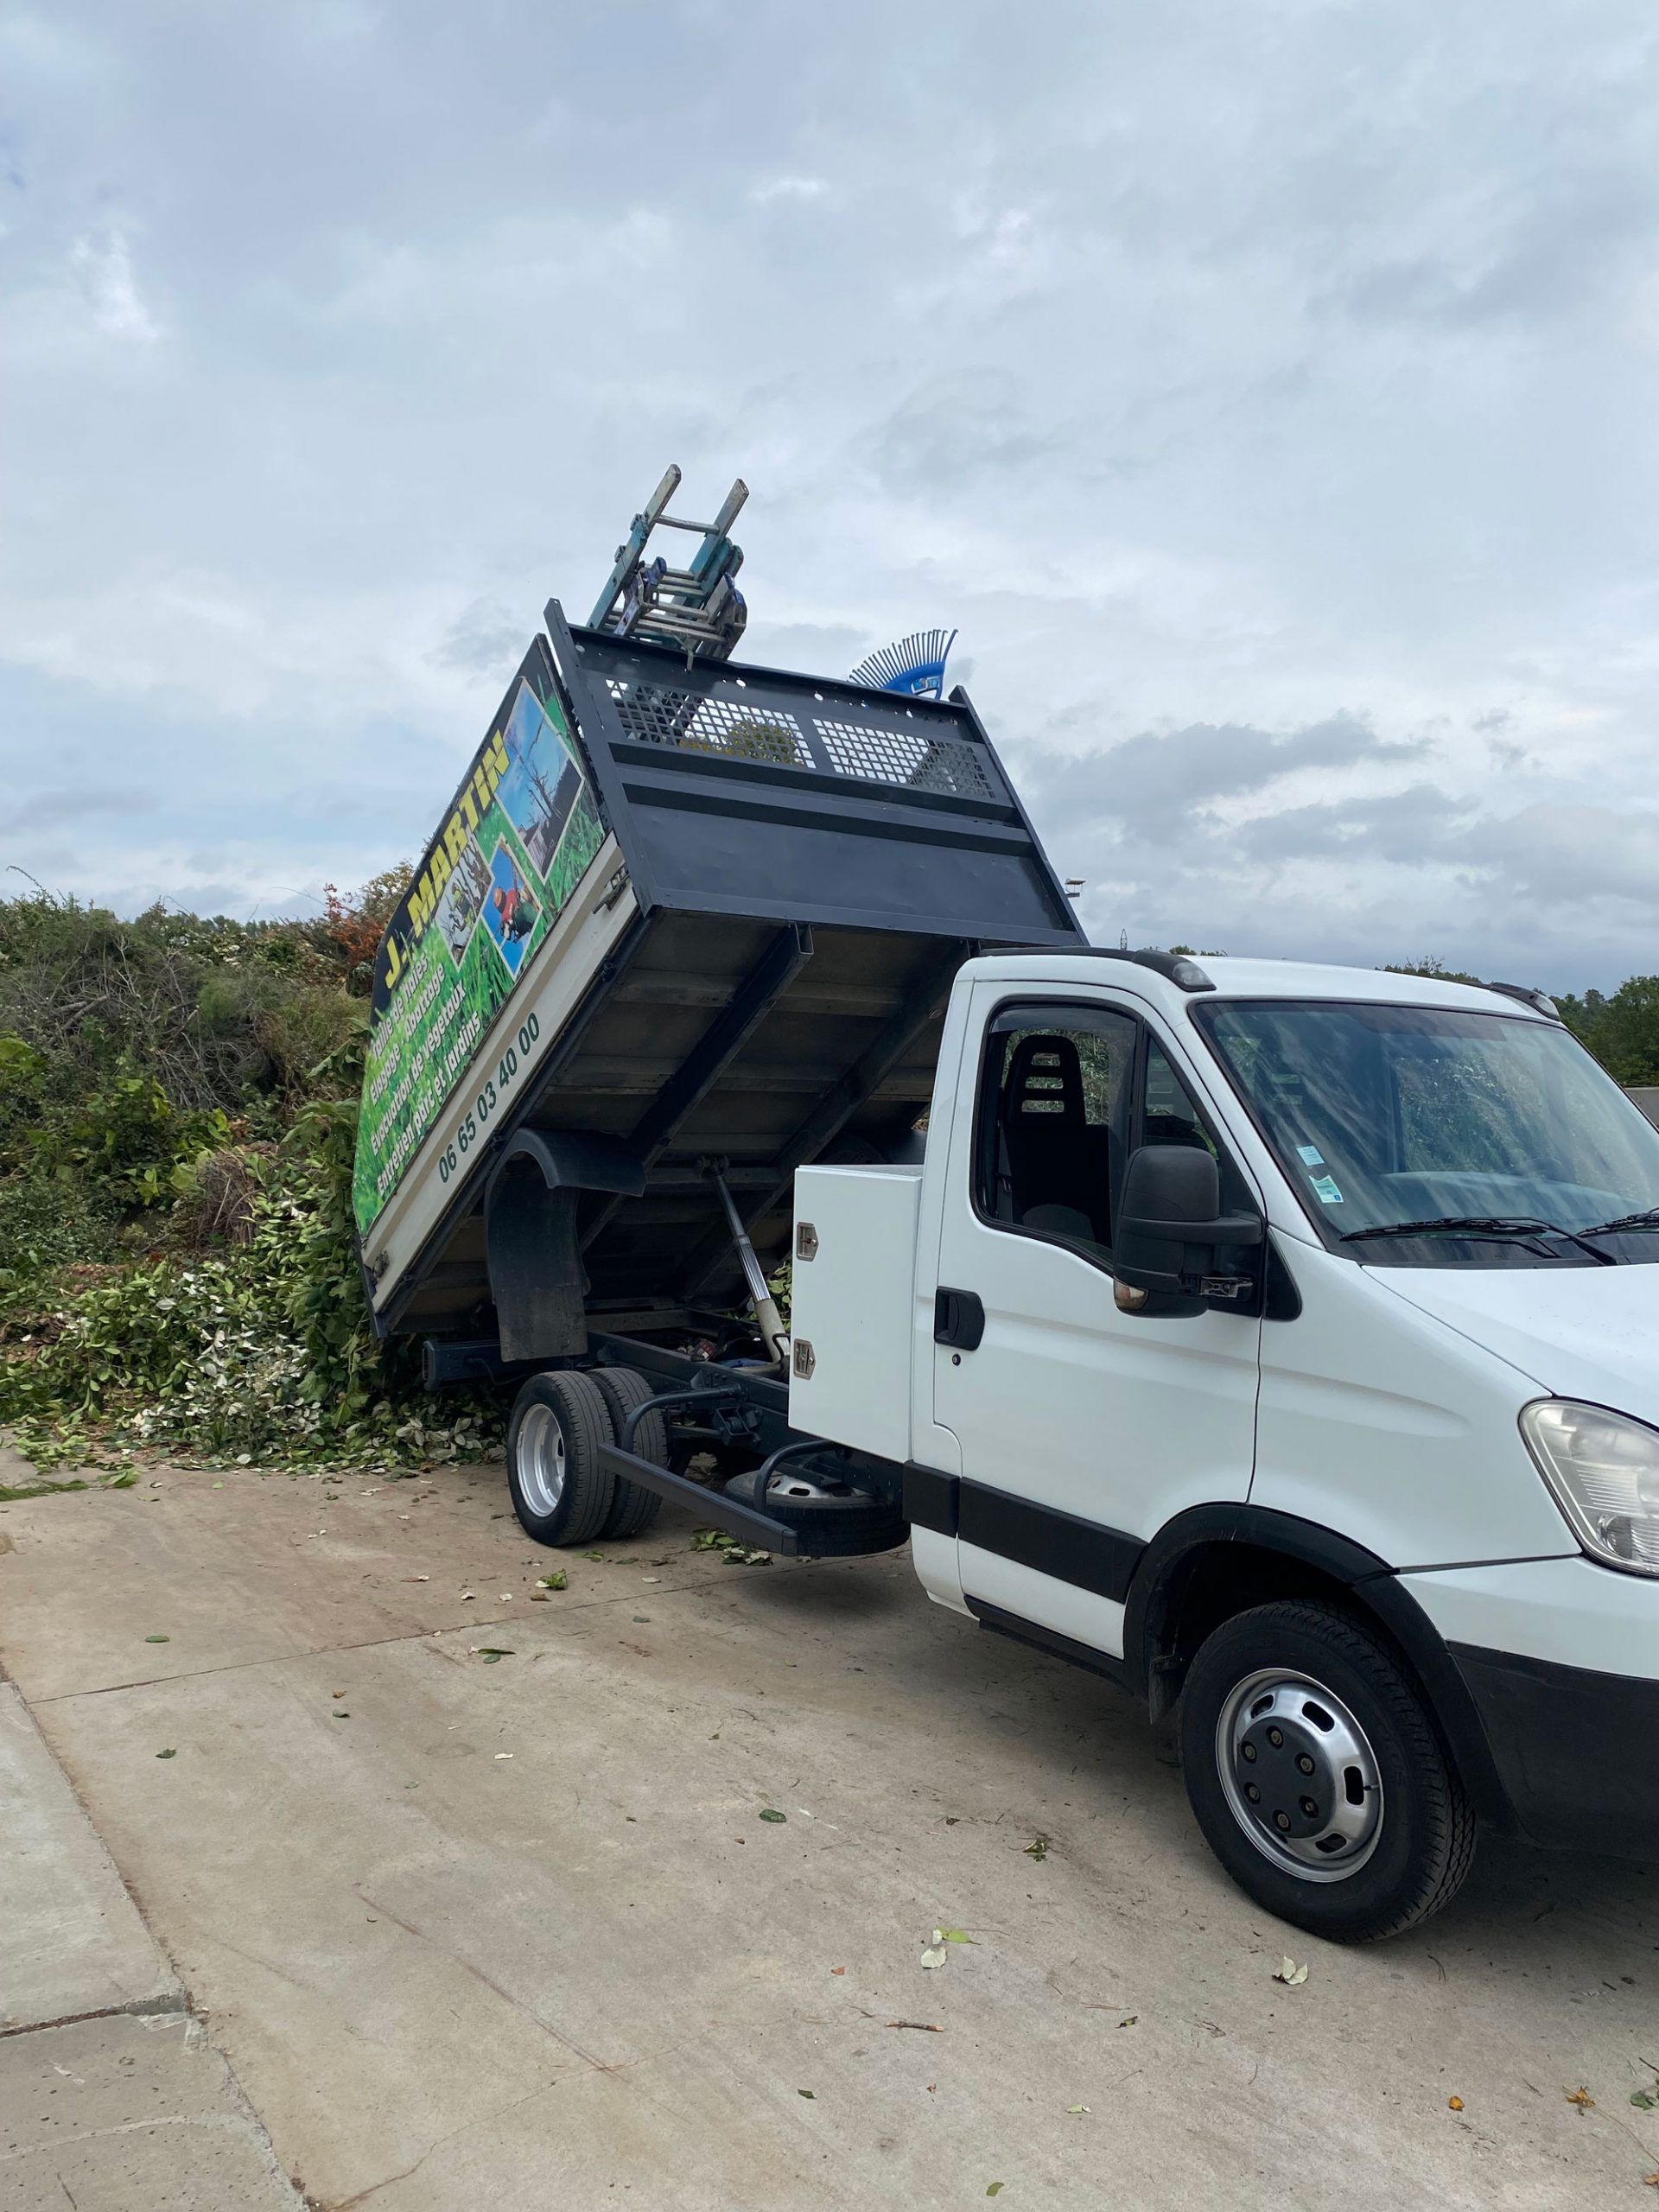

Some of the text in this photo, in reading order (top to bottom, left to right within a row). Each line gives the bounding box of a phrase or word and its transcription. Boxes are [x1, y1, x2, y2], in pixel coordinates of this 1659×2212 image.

[385, 728, 510, 988] J. MARTIN
[370, 1044, 401, 1105] Elagage
[404, 963, 445, 1041] Abattage
[371, 953, 428, 1060] Taille de haies
[371, 1074, 412, 1156] Evacuation
[411, 1053, 424, 1083] de
[378, 1011, 481, 1197] Entretien parc et jardins
[439, 1012, 540, 1184] 06 65 03 40 00
